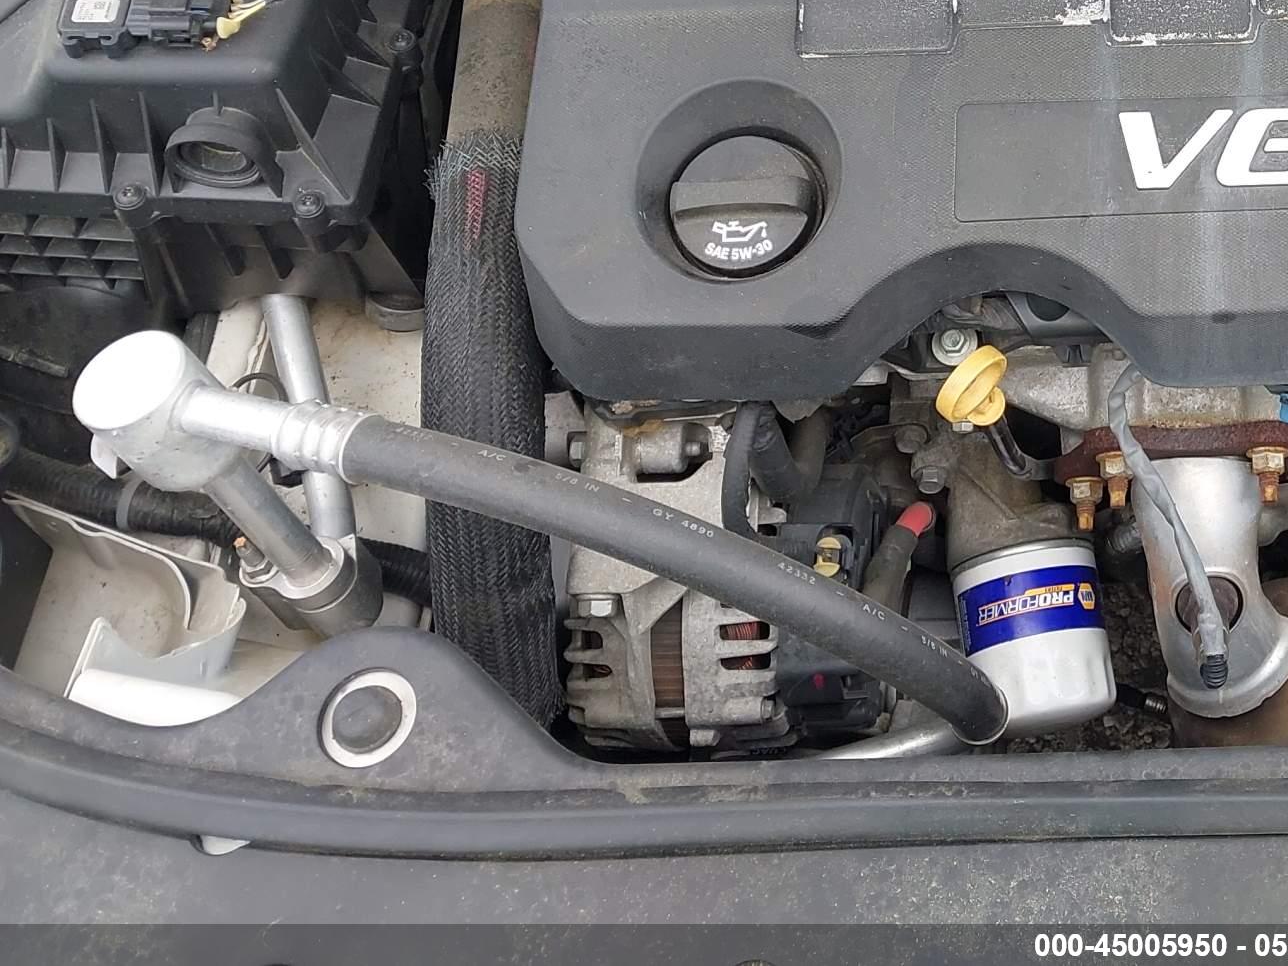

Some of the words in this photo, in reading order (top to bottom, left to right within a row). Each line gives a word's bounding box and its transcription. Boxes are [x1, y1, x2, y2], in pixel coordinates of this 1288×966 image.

[704, 242, 730, 260] SAE
[732, 240, 772, 260] 5W-30
[478, 449, 506, 462] A/C
[584, 482, 600, 492] IN
[681, 520, 714, 538] 4890
[862, 603, 886, 621] A/C
[979, 590, 1074, 623] PROFORMER
